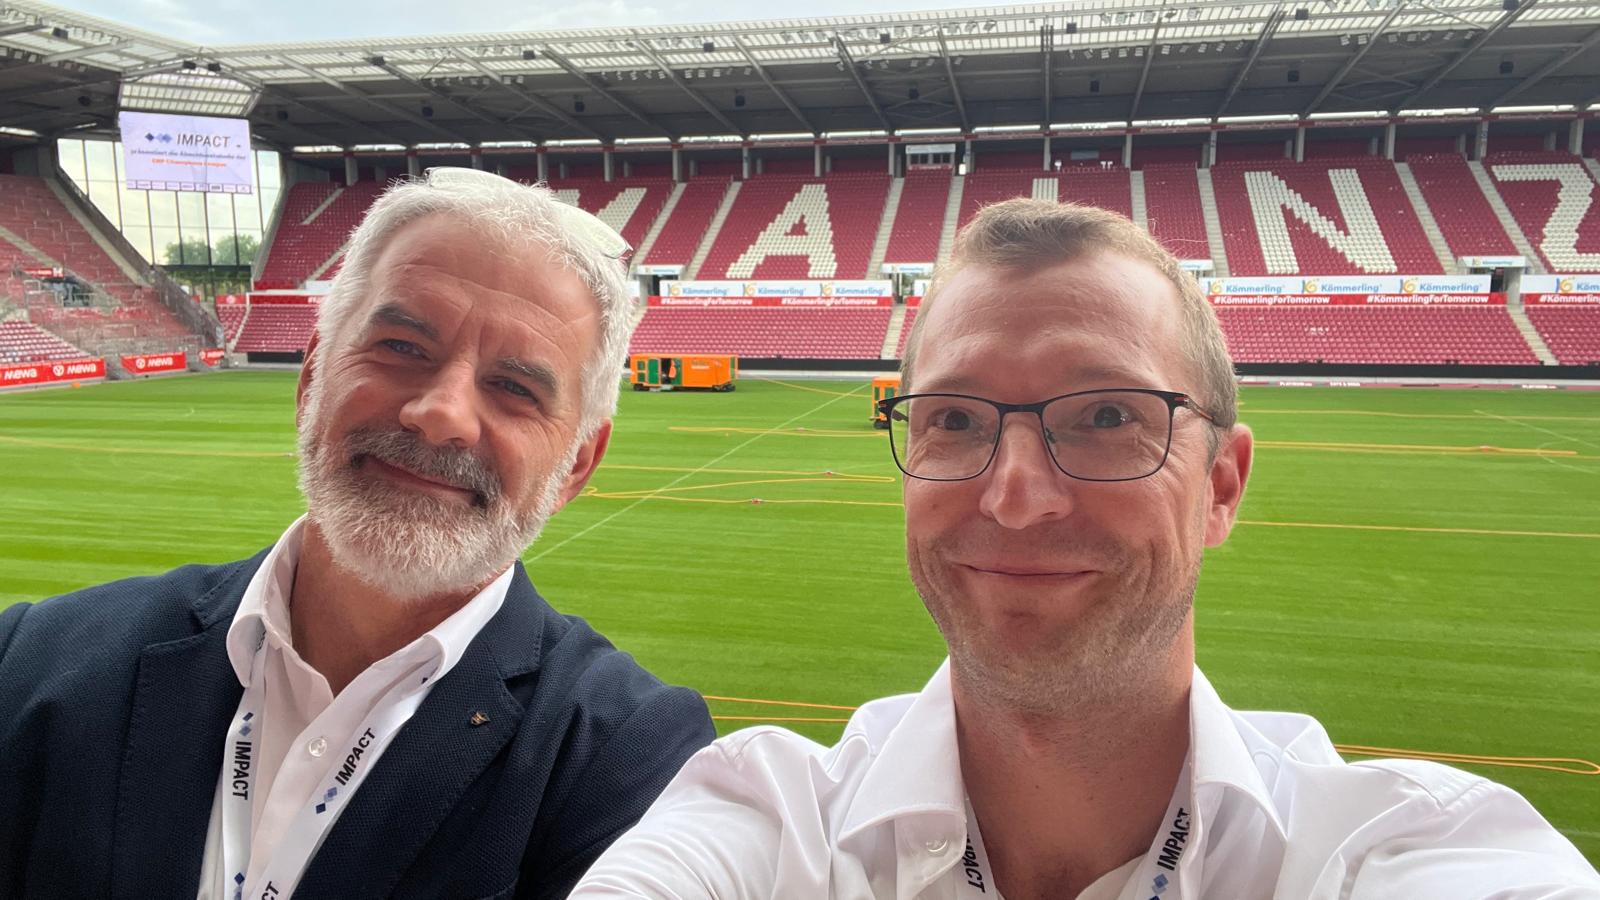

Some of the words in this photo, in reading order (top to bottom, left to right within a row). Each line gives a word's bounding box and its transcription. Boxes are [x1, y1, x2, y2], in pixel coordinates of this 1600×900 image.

[177, 133, 232, 148] IMPACT
[836, 286, 884, 296] Kömmerling
[1226, 284, 1282, 293] Kömmerling
[1321, 283, 1379, 293] Kömmerling
[1420, 282, 1479, 292] Kömmerling
[1214, 295, 1330, 305] #KömmerlingForTomorrow
[1366, 295, 1489, 304] #KömmerlingForTomorrow
[335, 728, 376, 786] IMPACT
[232, 741, 252, 800] IMPACT
[1157, 807, 1190, 871] IMPACT
